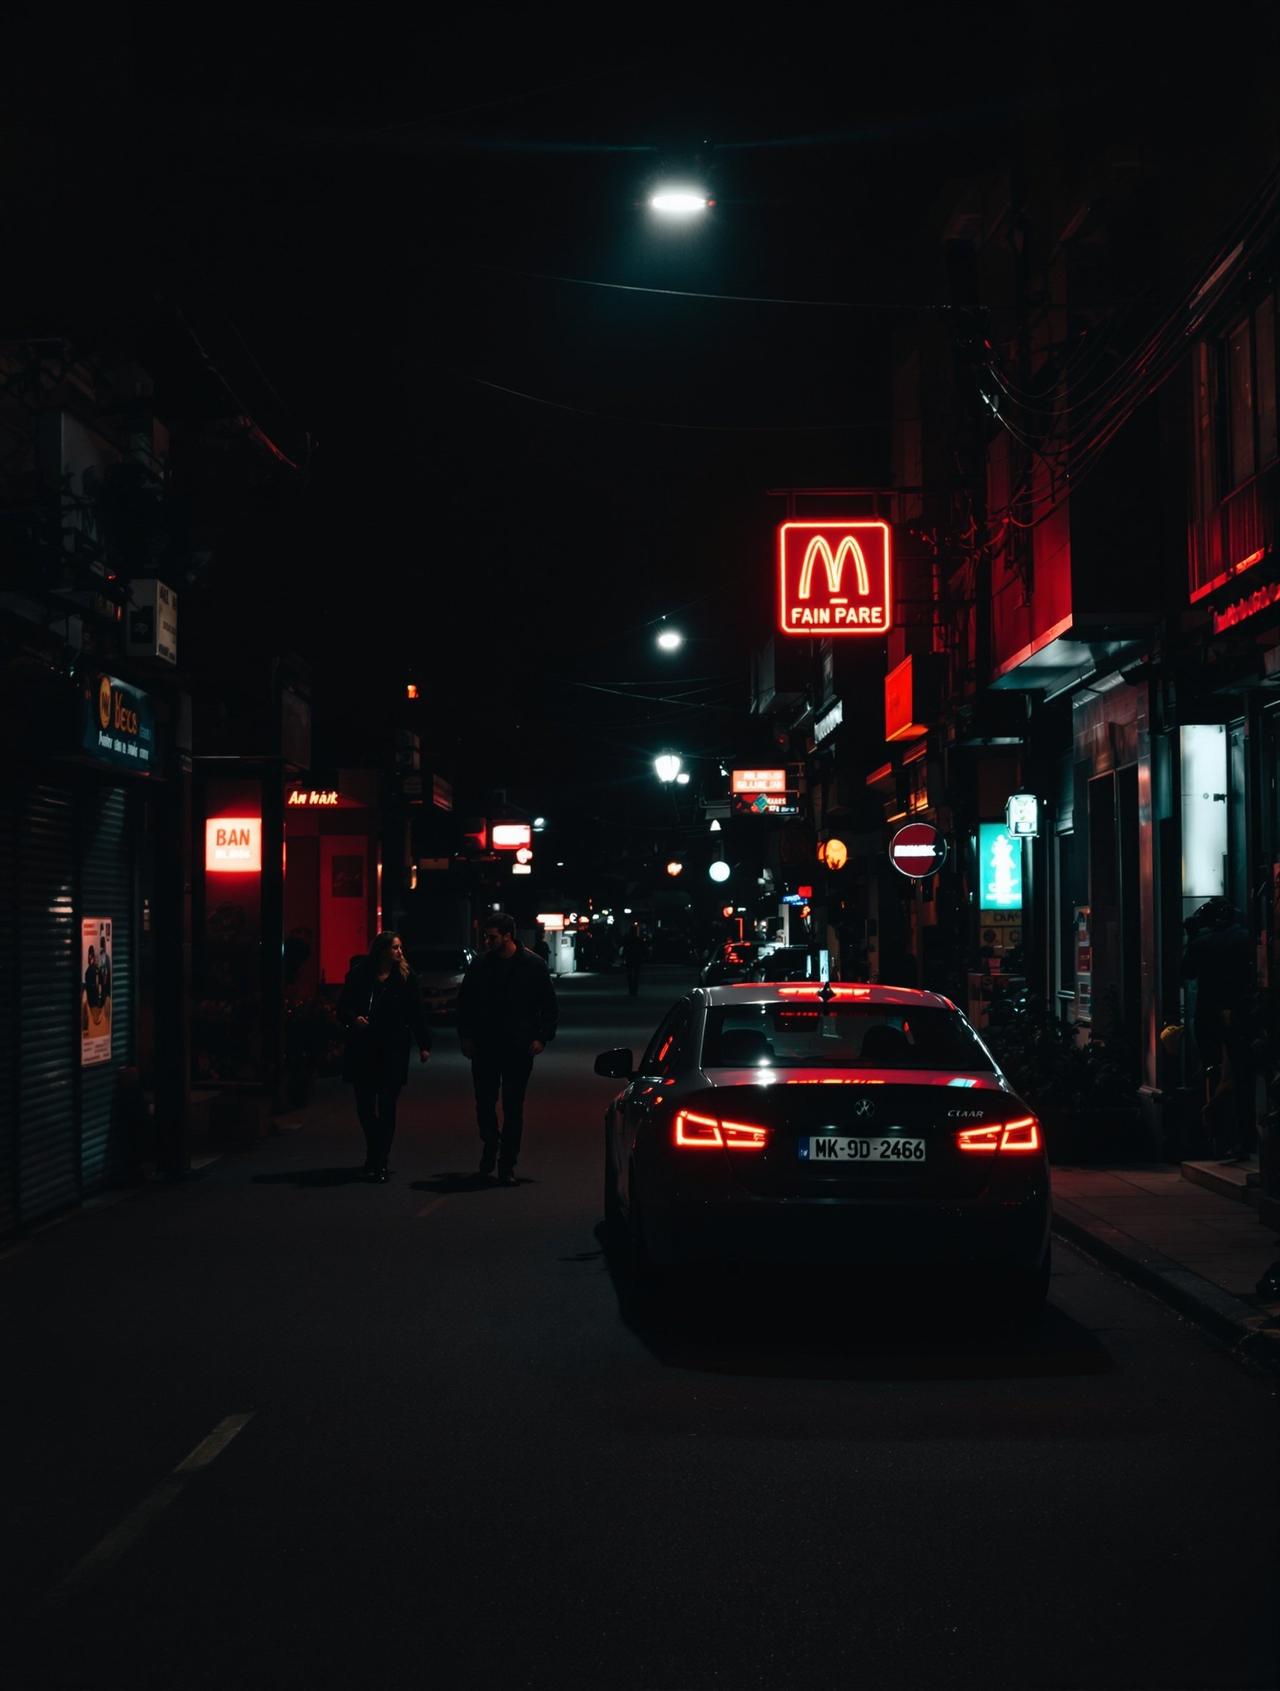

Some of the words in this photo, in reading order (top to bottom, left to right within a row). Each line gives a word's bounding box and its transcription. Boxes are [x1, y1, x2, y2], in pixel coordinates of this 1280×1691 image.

[791, 607, 831, 624] FAIN
[834, 606, 883, 624] PARE
[216, 828, 250, 847] BAN
[815, 1139, 925, 1160] MK-9D-2466
